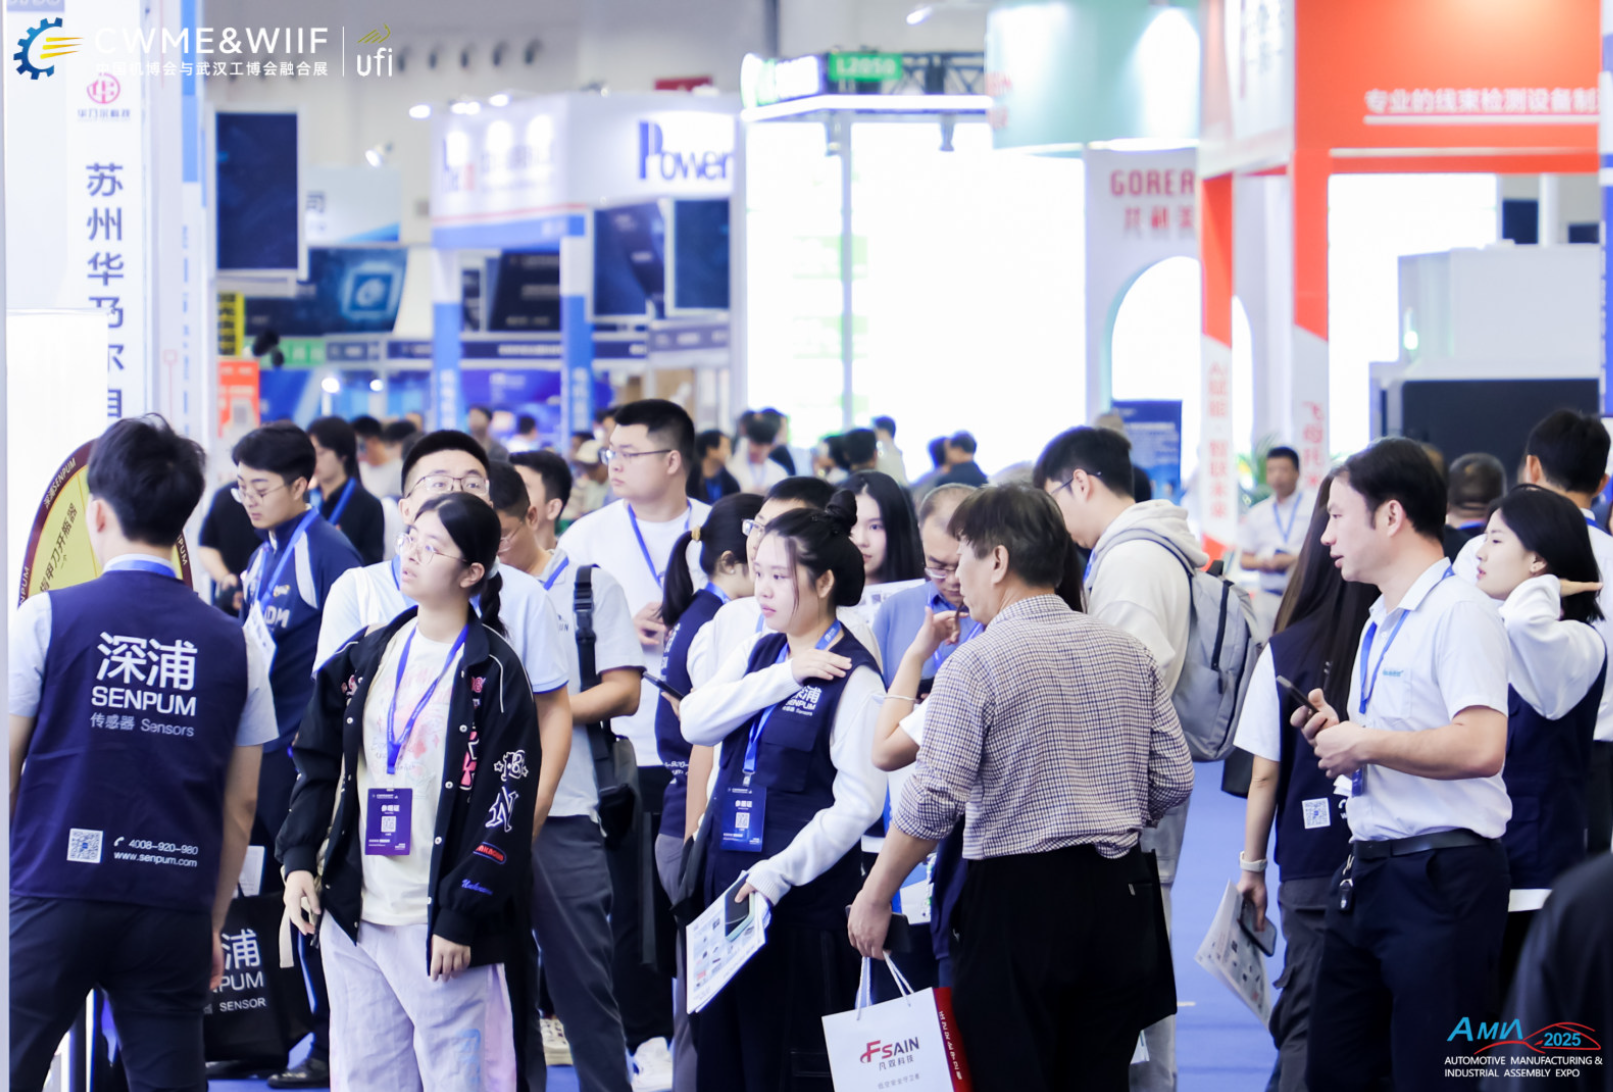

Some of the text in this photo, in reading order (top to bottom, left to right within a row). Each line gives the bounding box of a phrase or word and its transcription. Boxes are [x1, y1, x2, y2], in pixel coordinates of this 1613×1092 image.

[1364, 87, 1600, 114] 专业的线束检测设备制
[97, 631, 198, 690] 深浦
[91, 685, 197, 716] SENPUM
[90, 712, 195, 737] 传感器 Sensors
[113, 851, 198, 867] www.senpum.com
[128, 839, 199, 855] 4008-920-980
[221, 928, 261, 970] 浦
[213, 971, 264, 993] PUM
[219, 997, 267, 1012] SENSOR
